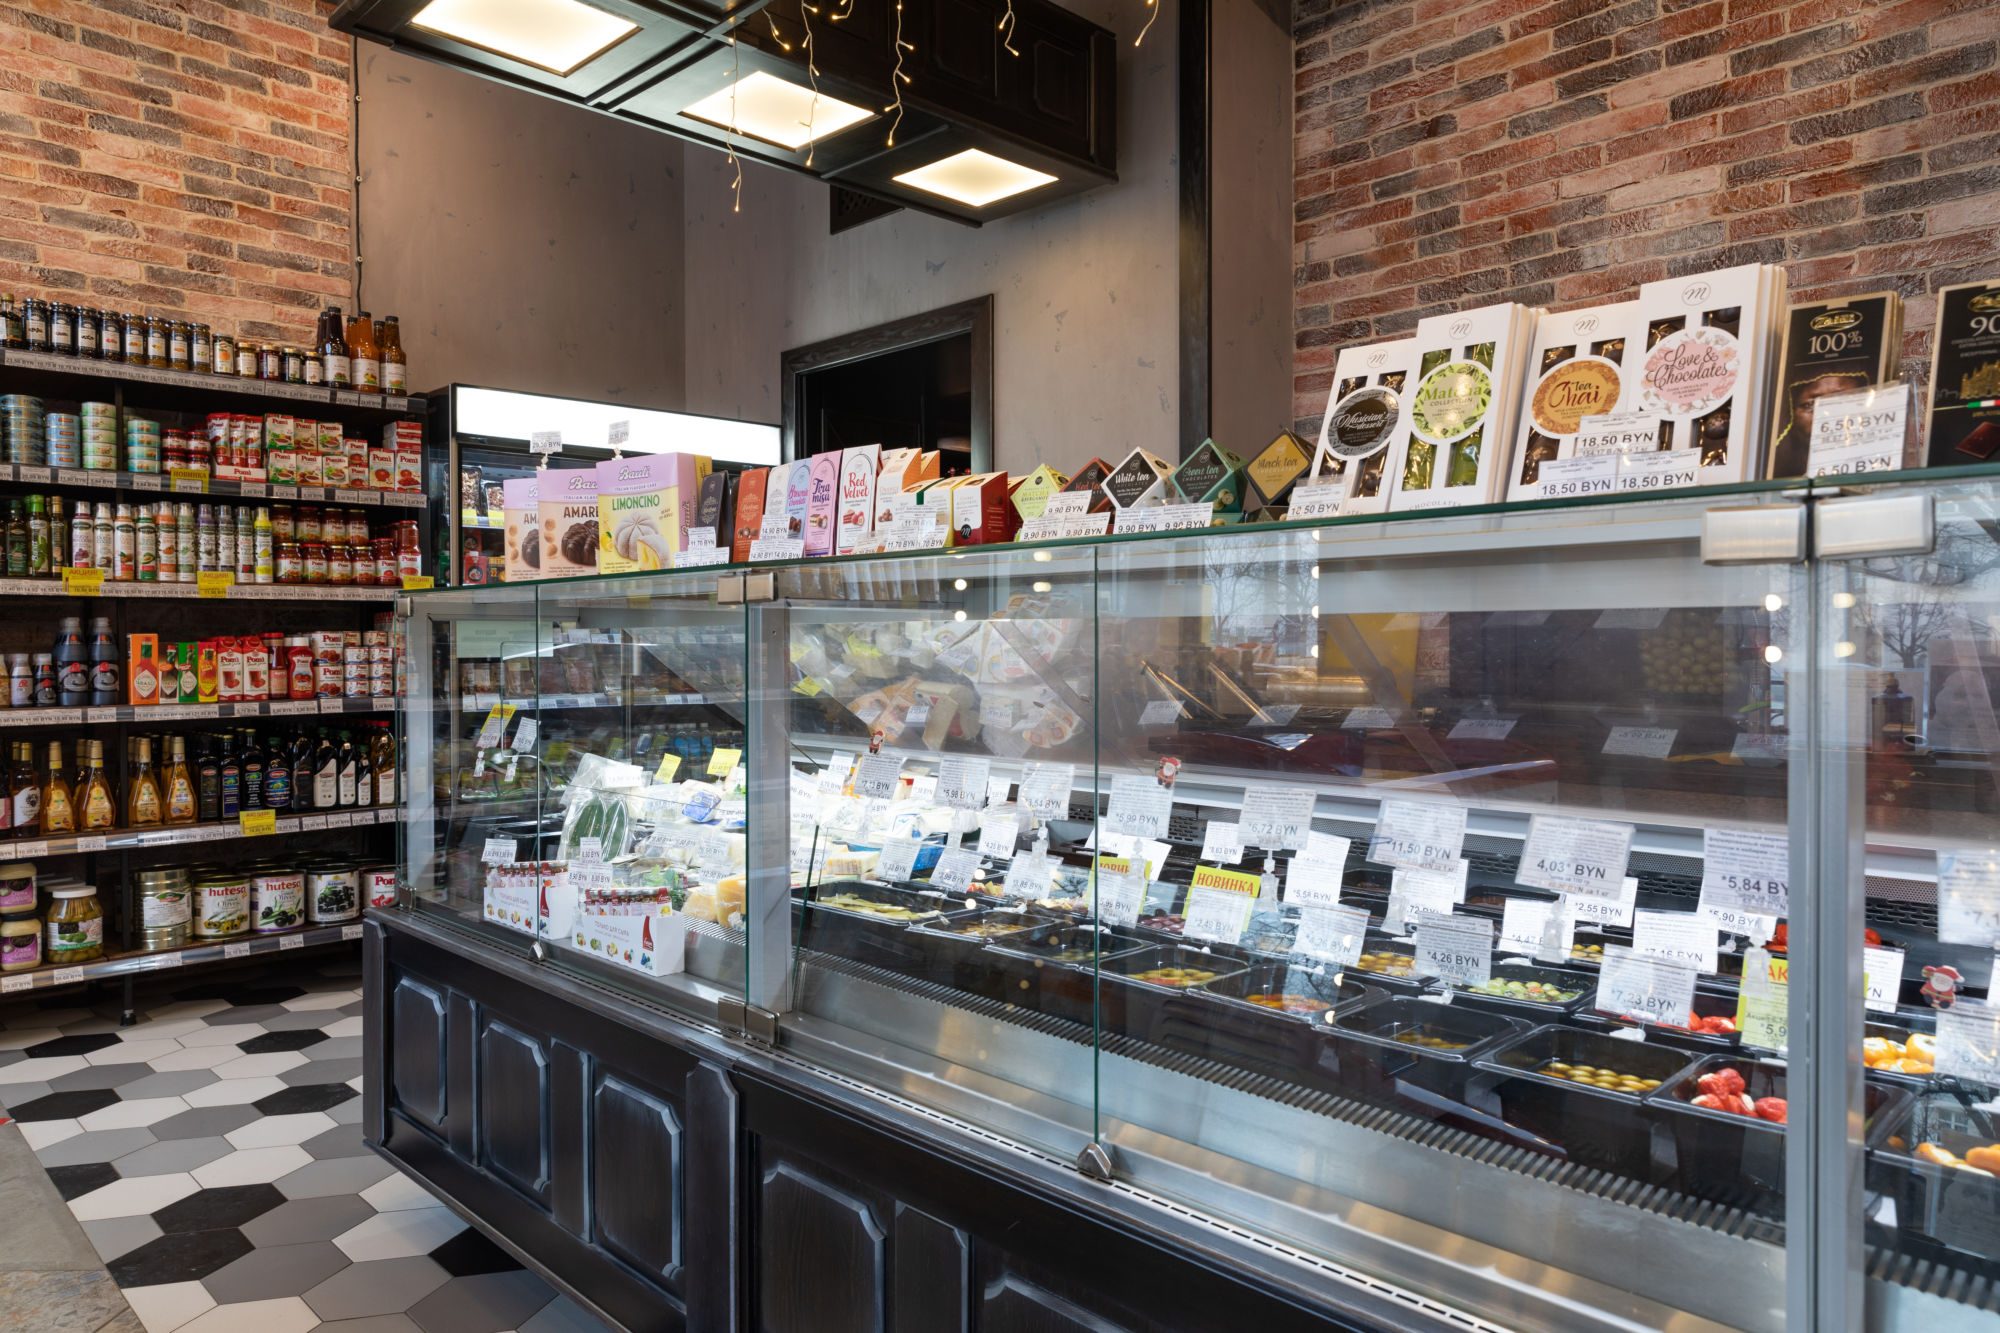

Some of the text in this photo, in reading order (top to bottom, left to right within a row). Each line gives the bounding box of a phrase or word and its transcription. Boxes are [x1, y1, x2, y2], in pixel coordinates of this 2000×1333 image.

[1664, 344, 1719, 370] Love &
[1646, 360, 1728, 391] Chocolates
[1571, 381, 1593, 392] Tea
[1549, 380, 1602, 408] Chai
[1336, 411, 1388, 429] Musician's
[1358, 420, 1386, 431] dessert
[1820, 412, 1896, 434] 6,50 BYN
[1582, 432, 1654, 448] 18,50 BYN
[1258, 457, 1298, 468] Black tea
[1855, 456, 1892, 473] BYN
[618, 466, 650, 481] Bauli
[1183, 465, 1220, 477] Green tea
[849, 472, 866, 488] Red
[1116, 472, 1150, 484] White tea
[1621, 472, 1695, 489] 18,50 BYN
[812, 478, 830, 495] Tira
[844, 485, 868, 500] Velvet
[1542, 479, 1612, 496] 18,50 BYN
[612, 494, 660, 511] LIMONCINO
[1317, 503, 1340, 513] BYN
[1138, 524, 1156, 532] BYN
[1186, 520, 1206, 528] BYN
[876, 782, 890, 790] BYN
[960, 792, 975, 800] BYN
[1044, 800, 1062, 809] BYN
[1275, 825, 1298, 836] BYN
[1424, 846, 1451, 860] BYN
[895, 865, 906, 873] BYN
[1574, 864, 1606, 880] BYN
[952, 874, 966, 884] BYN
[1196, 872, 1254, 895] НОВИНКА
[1028, 882, 1044, 891] BYN
[1313, 892, 1331, 902] BYN
[1600, 906, 1622, 918] BYN
[1456, 956, 1480, 968] BYN
[1678, 950, 1703, 962] BYN
[1646, 997, 1676, 1012] BYN
